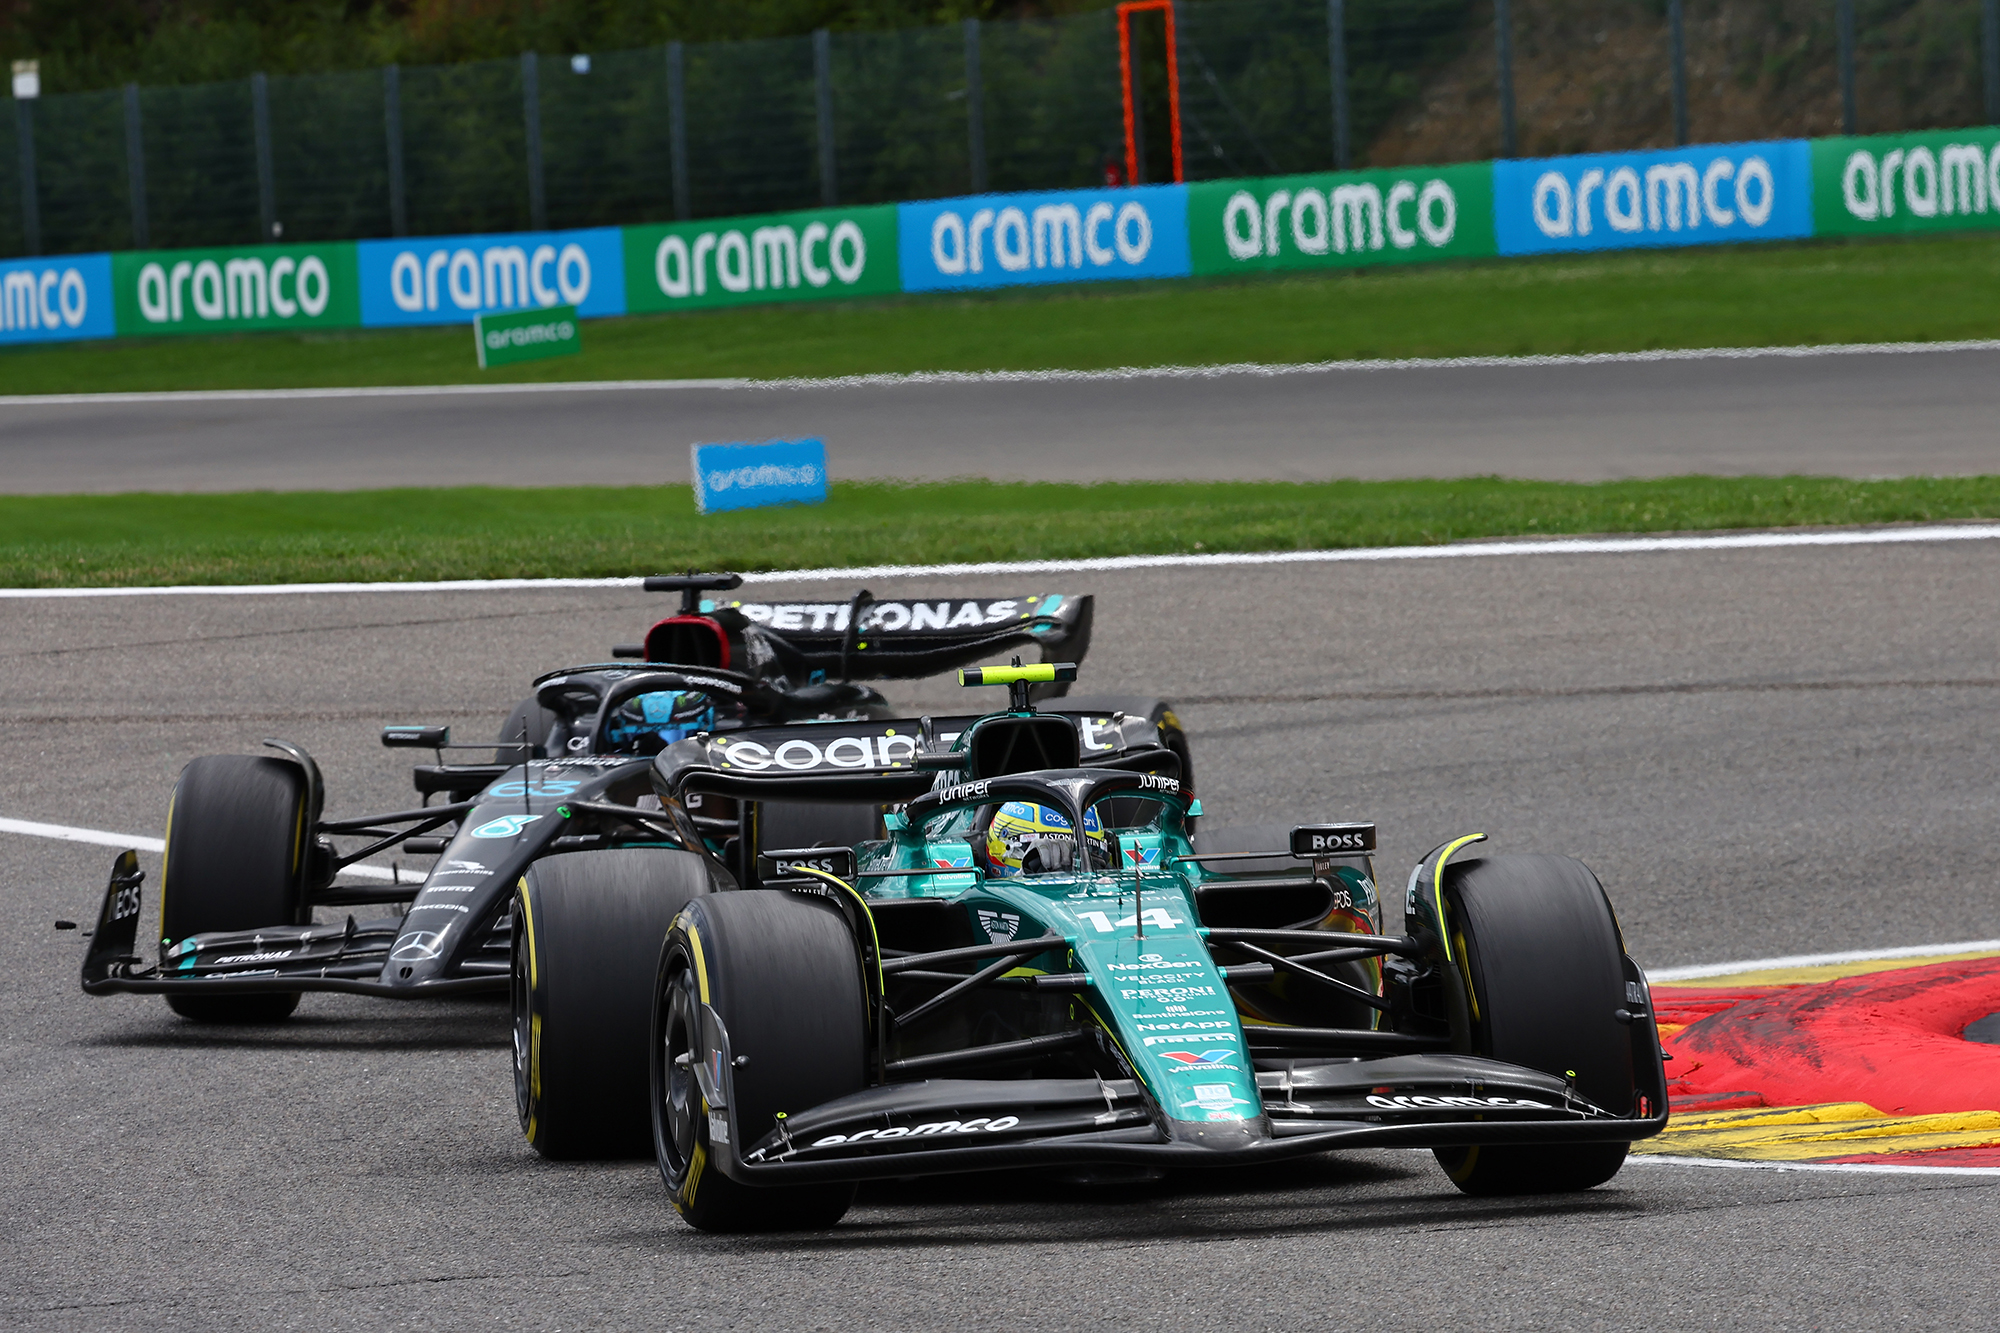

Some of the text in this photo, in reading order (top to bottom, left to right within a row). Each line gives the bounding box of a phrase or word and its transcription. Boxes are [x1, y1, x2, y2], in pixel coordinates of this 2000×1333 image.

[1533, 156, 1774, 238] aramco
[1223, 179, 1456, 260] aramco
[931, 201, 1152, 276] aramco
[655, 220, 865, 297] aramco
[138, 256, 329, 322] aramco
[391, 243, 591, 311] aramco
[0, 267, 87, 330] mco
[486, 321, 574, 349] aramco
[708, 464, 824, 492] aramco
[724, 717, 1112, 770] cognt
[488, 781, 581, 797] 63
[1312, 833, 1364, 850] BOSS
[936, 872, 972, 880] Valvoline
[1074, 907, 1184, 933] 14
[213, 949, 293, 965] PETRONAS
[1106, 960, 1202, 971] NexGen
[1114, 972, 1205, 982] VELOCITY
[1120, 986, 1216, 997] PERONI
[1137, 1020, 1232, 1032] NetApp
[1142, 1033, 1237, 1047] PIRELLI
[1168, 1063, 1240, 1073] Valvoline
[1365, 1095, 1553, 1110] aramco
[811, 1115, 1020, 1148] aramco
